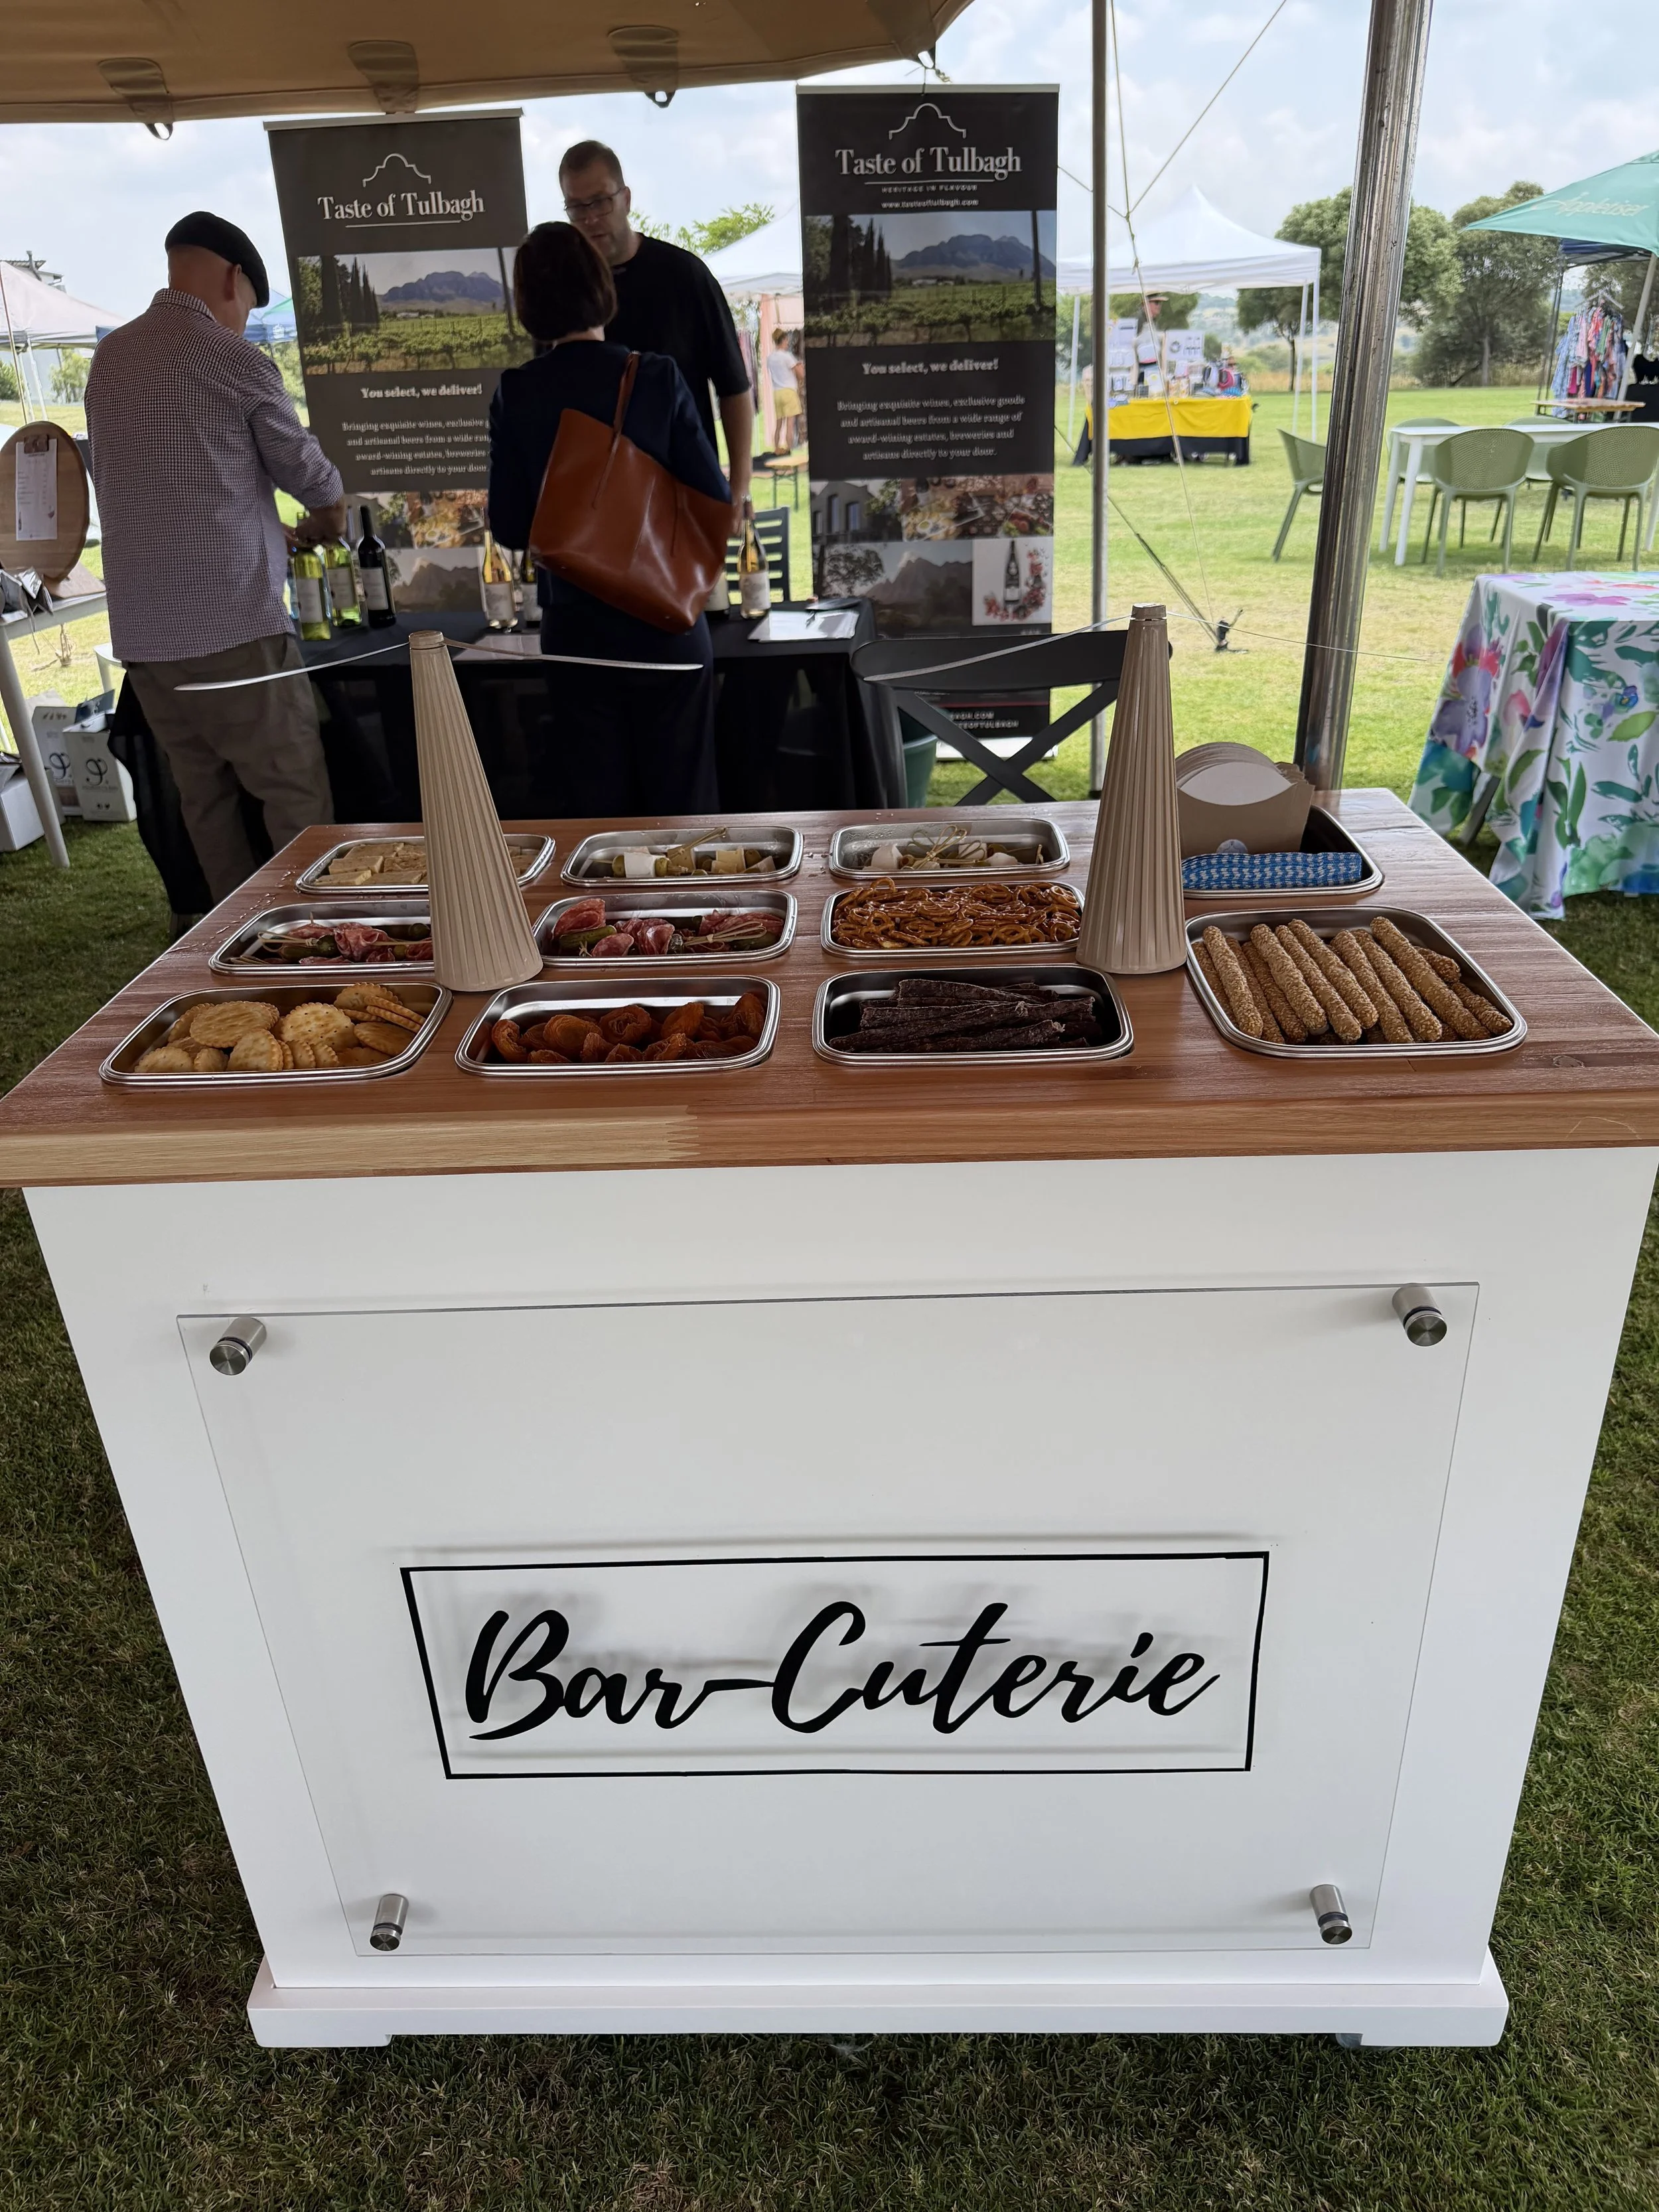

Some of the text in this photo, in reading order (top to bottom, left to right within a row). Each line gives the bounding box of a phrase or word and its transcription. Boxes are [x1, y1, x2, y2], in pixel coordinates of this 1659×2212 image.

[835, 147, 1023, 181] Taste of Tulbagh
[317, 189, 486, 222] Taste of Tulbagh
[881, 198, 979, 209] www.tasteoftulbagh.com
[1532, 192, 1650, 217] Appletiser
[862, 358, 999, 376] You select, we deliver!
[360, 383, 482, 398] You select, we deliver!
[837, 395, 1025, 412] Bringing exquisite wines, exclusive goods
[342, 421, 379, 433] Bringing
[380, 420, 417, 431] exquisite
[417, 419, 445, 429] wines,
[445, 417, 484, 428] exclusive
[841, 417, 858, 427] and
[859, 415, 901, 427] artisanal
[902, 415, 927, 426] beers
[928, 415, 950, 425] from
[960, 413, 983, 423] wide
[983, 414, 1010, 425] range
[1011, 411, 1023, 421] of
[346, 437, 362, 446] and
[364, 435, 399, 446] artisanal
[400, 435, 424, 444] beers
[425, 434, 445, 443] from
[453, 433, 472, 443] wide
[474, 434, 491, 443] ran
[914, 433, 949, 443] estates,
[950, 430, 995, 441] breweries
[996, 429, 1014, 439] and
[414, 451, 445, 459] estates,
[445, 449, 486, 458] breweries
[863, 447, 997, 461] artisans directly to your door.
[371, 467, 403, 475] artisans
[403, 465, 436, 476] directly
[437, 465, 446, 473] to
[447, 466, 465, 475] your
[465, 1601, 1220, 1740] Bar-Cuterie
